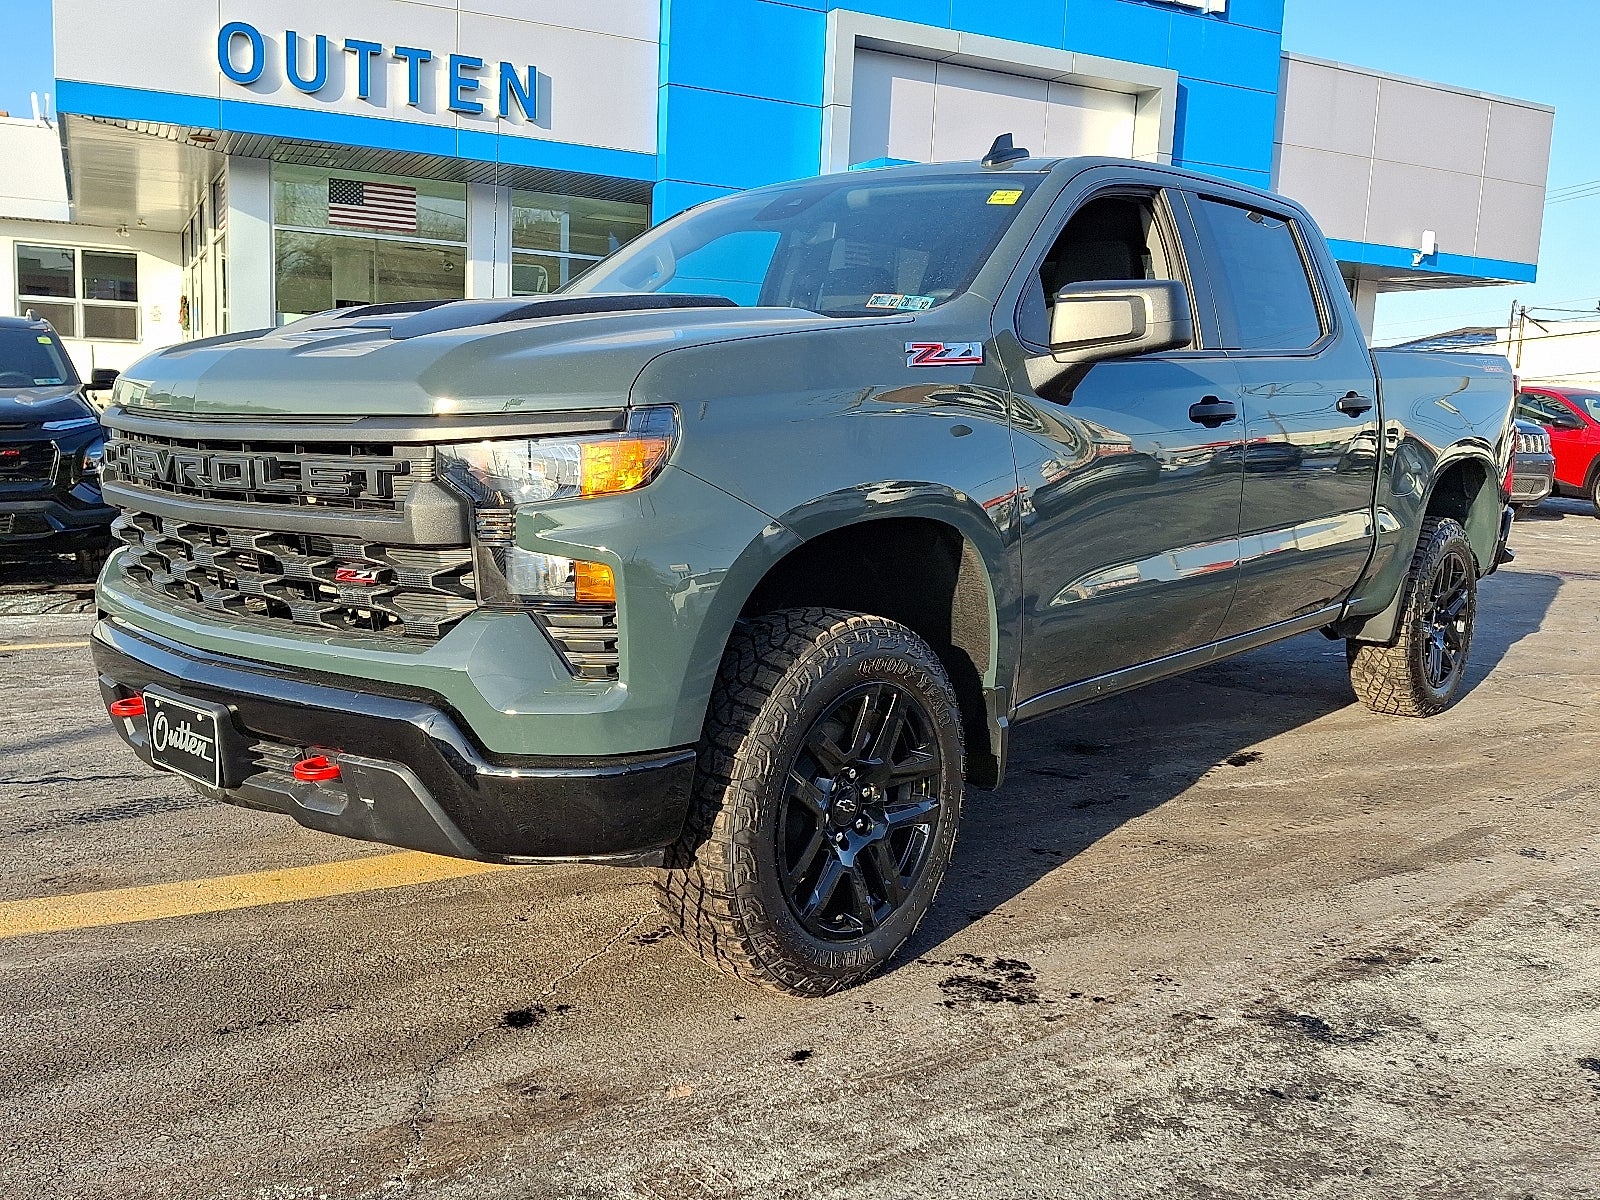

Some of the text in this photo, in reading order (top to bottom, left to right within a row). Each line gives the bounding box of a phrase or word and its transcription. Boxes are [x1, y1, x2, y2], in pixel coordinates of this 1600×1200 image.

[217, 21, 537, 121] OUTTEN
[904, 341, 983, 367] Z71
[104, 440, 411, 497] CHEVROLET
[858, 658, 951, 729] GOODYEAR
[152, 711, 214, 763] Outten
